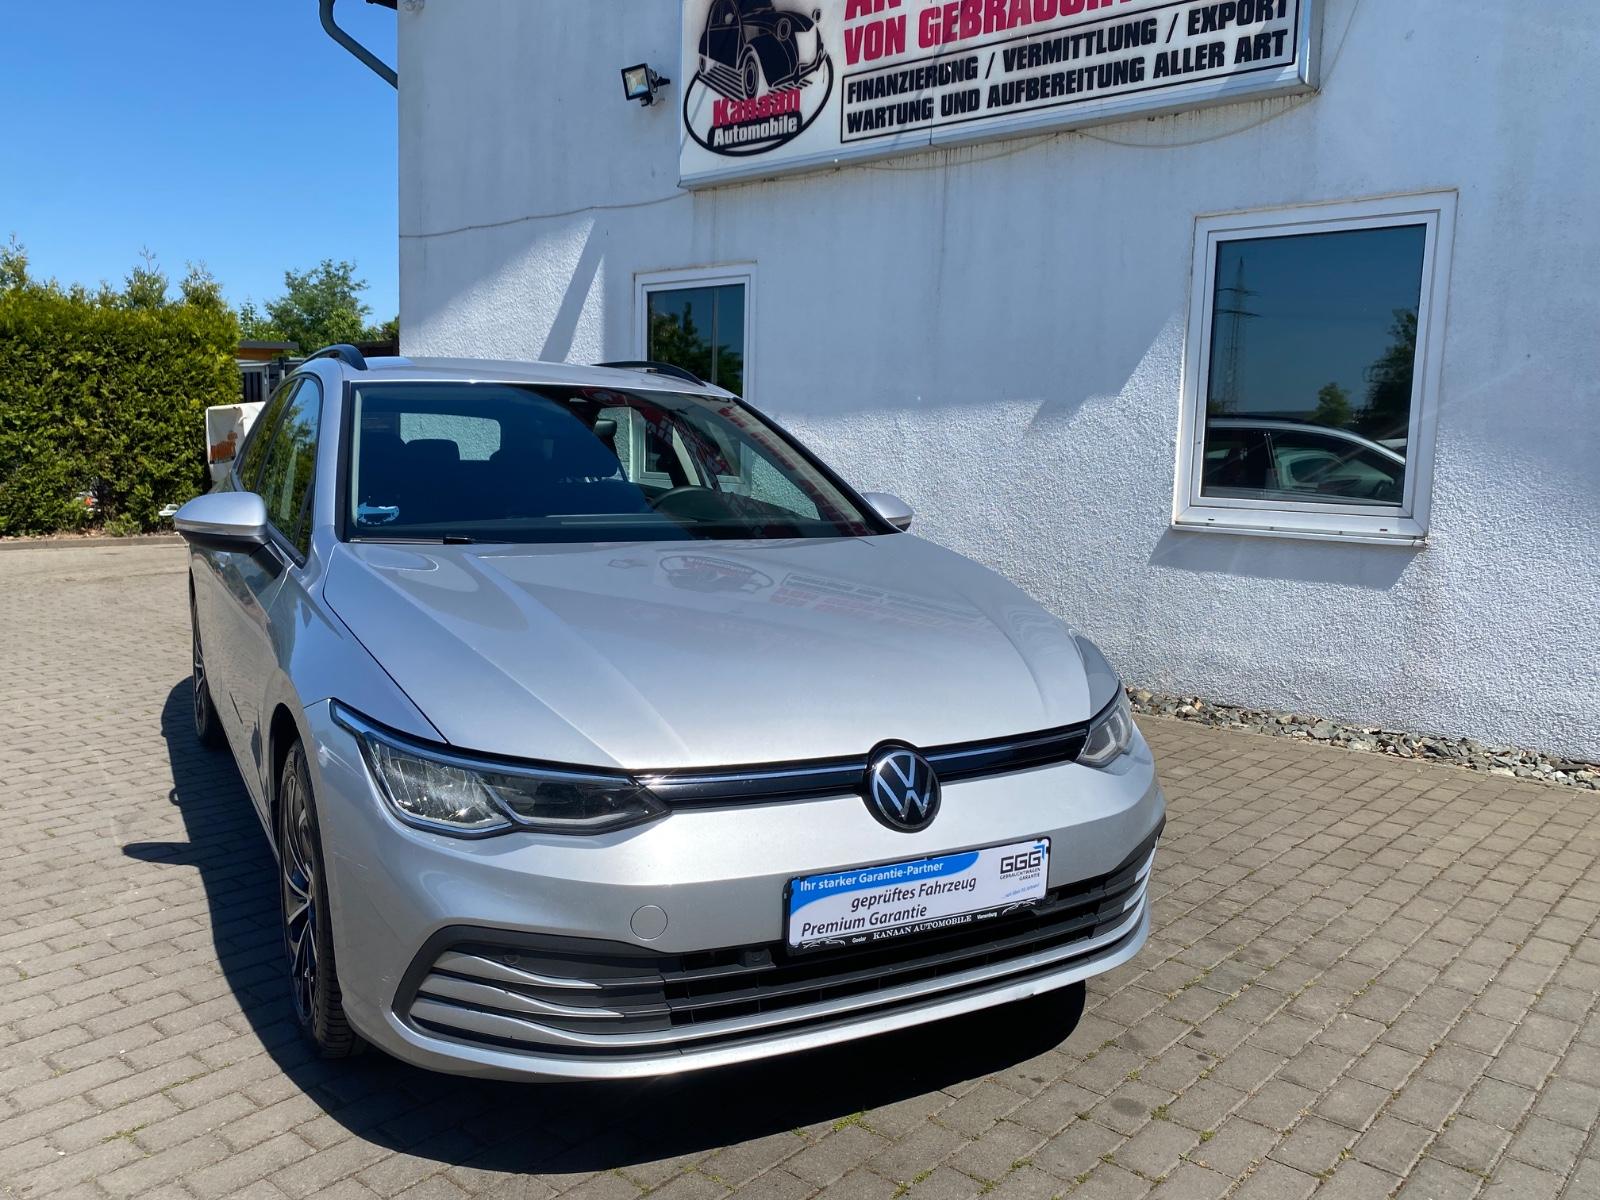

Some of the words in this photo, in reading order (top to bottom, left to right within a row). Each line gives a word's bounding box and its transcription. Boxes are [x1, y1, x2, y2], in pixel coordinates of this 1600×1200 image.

[844, 14, 906, 66] VON
[847, 56, 979, 104] FINANZIERUNG
[985, 52, 996, 79] /
[1002, 18, 1157, 73] VERMITTLUNG
[1166, 12, 1179, 43] /
[1187, 0, 1287, 36] EXPORT
[847, 98, 934, 133] WARTUNG
[940, 88, 981, 117] UND
[987, 56, 1145, 108] AUFBEREITUNG
[1153, 41, 1225, 79] ALLER
[1234, 29, 1288, 64] ART
[713, 88, 800, 127] Kanaan
[713, 114, 798, 147] Automobile
[800, 880, 816, 892] Ihr
[818, 874, 856, 889] starker
[860, 861, 944, 884] Garantie-Partner
[1000, 850, 1041, 875] GGG
[851, 888, 915, 912] geprüftes
[918, 877, 977, 899] Fahrzeug
[801, 915, 866, 937] Premium
[869, 904, 927, 926] Garantie
[872, 925, 912, 941] KANAAN
[913, 914, 972, 933] AUTOMOBILE
